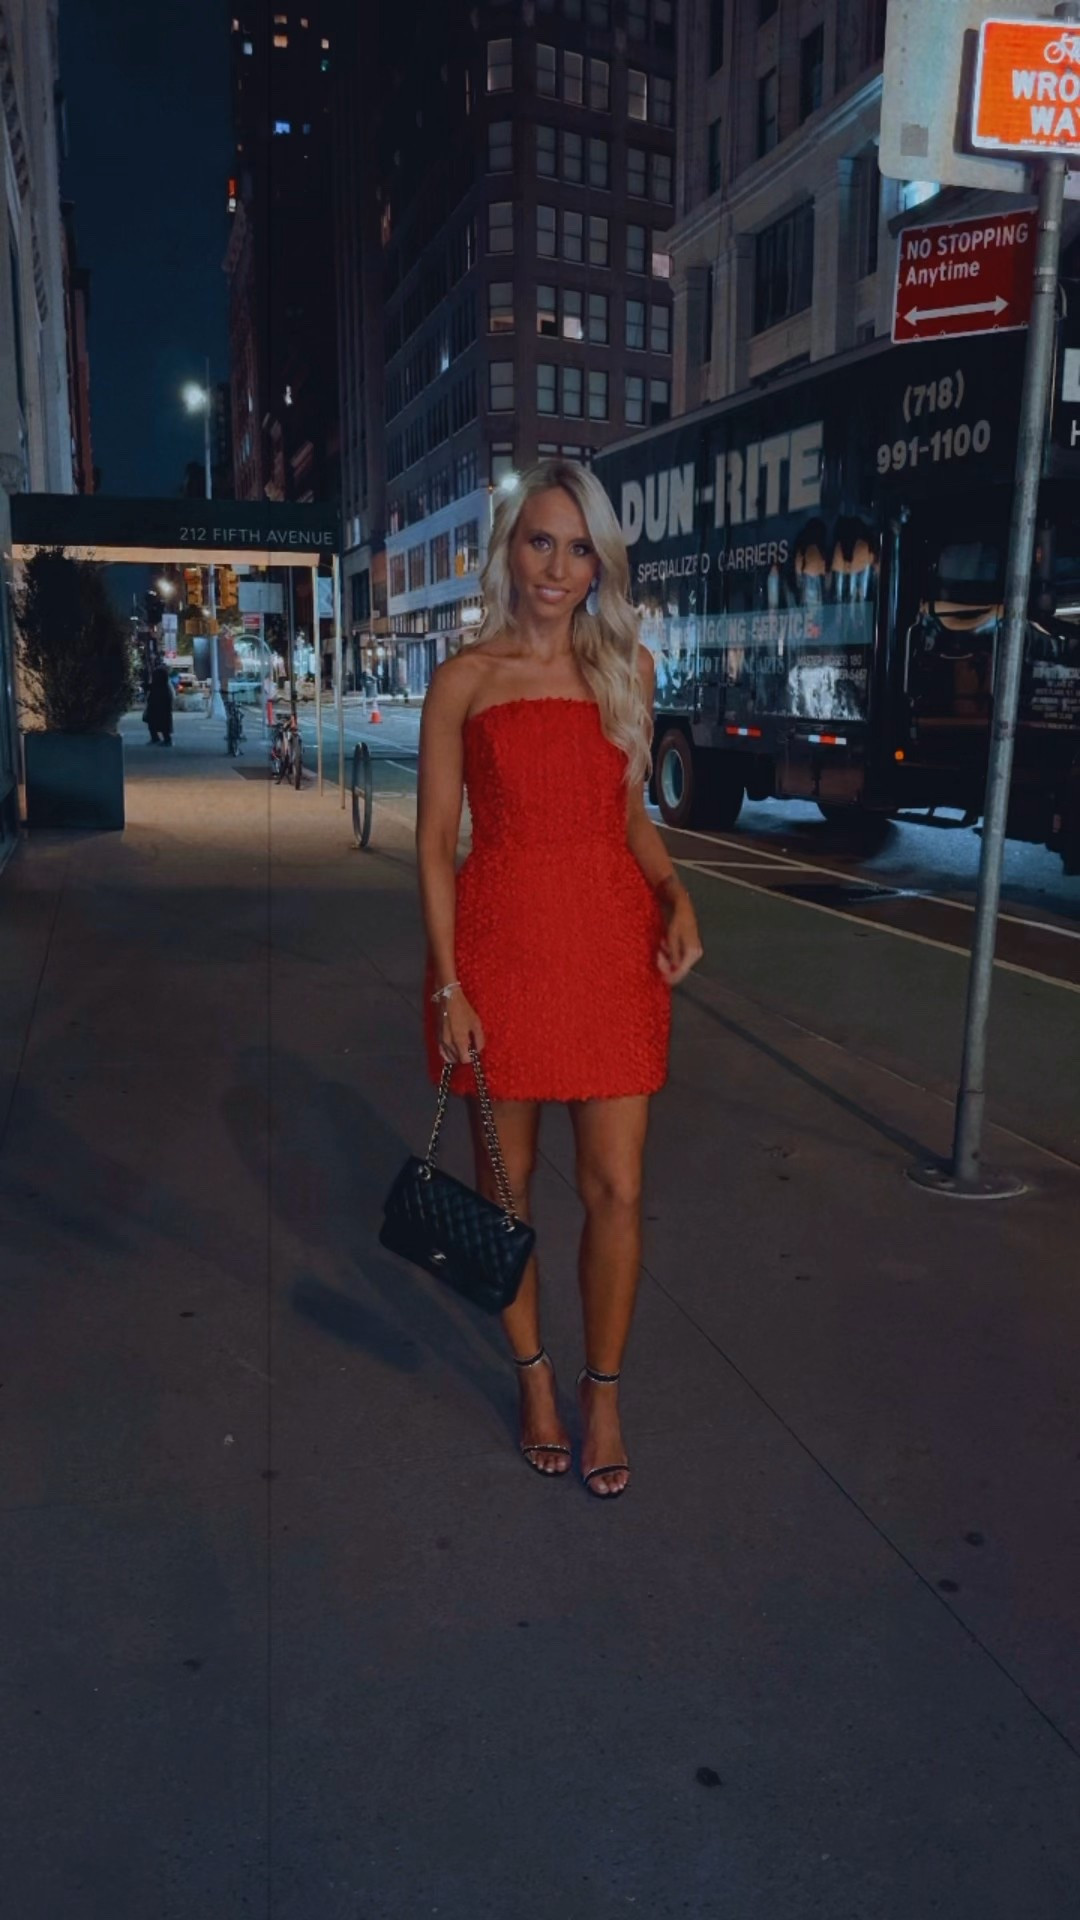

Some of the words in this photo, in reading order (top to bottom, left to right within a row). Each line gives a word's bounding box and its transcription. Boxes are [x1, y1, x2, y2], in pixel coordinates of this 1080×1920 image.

[906, 239, 931, 260] NO
[937, 222, 1028, 256] STOPPING
[905, 260, 980, 288] Anytime
[903, 368, 965, 423] (718)
[876, 420, 991, 474] 991-1100
[621, 422, 824, 547] DUN-RITE
[179, 527, 207, 541] 212
[213, 528, 261, 542] FIFTH
[266, 530, 334, 545] AVENUE
[718, 539, 789, 573] CARRIERS
